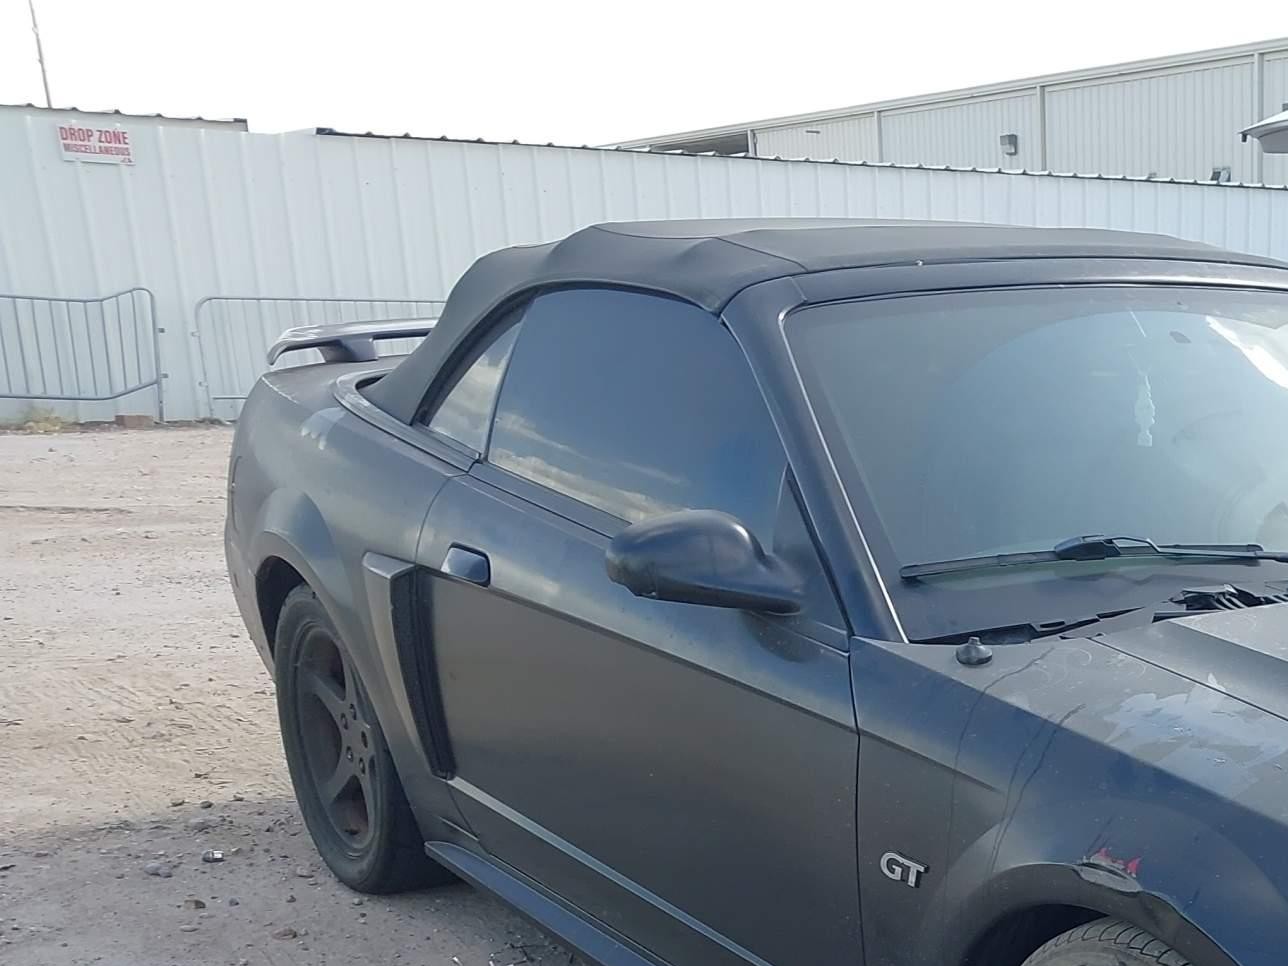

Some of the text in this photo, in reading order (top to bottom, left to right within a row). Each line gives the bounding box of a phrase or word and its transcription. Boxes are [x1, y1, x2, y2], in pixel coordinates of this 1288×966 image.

[59, 127, 129, 144] DROP ZONE
[63, 143, 130, 156] MISCELLANEOUS
[880, 852, 926, 888] GT
